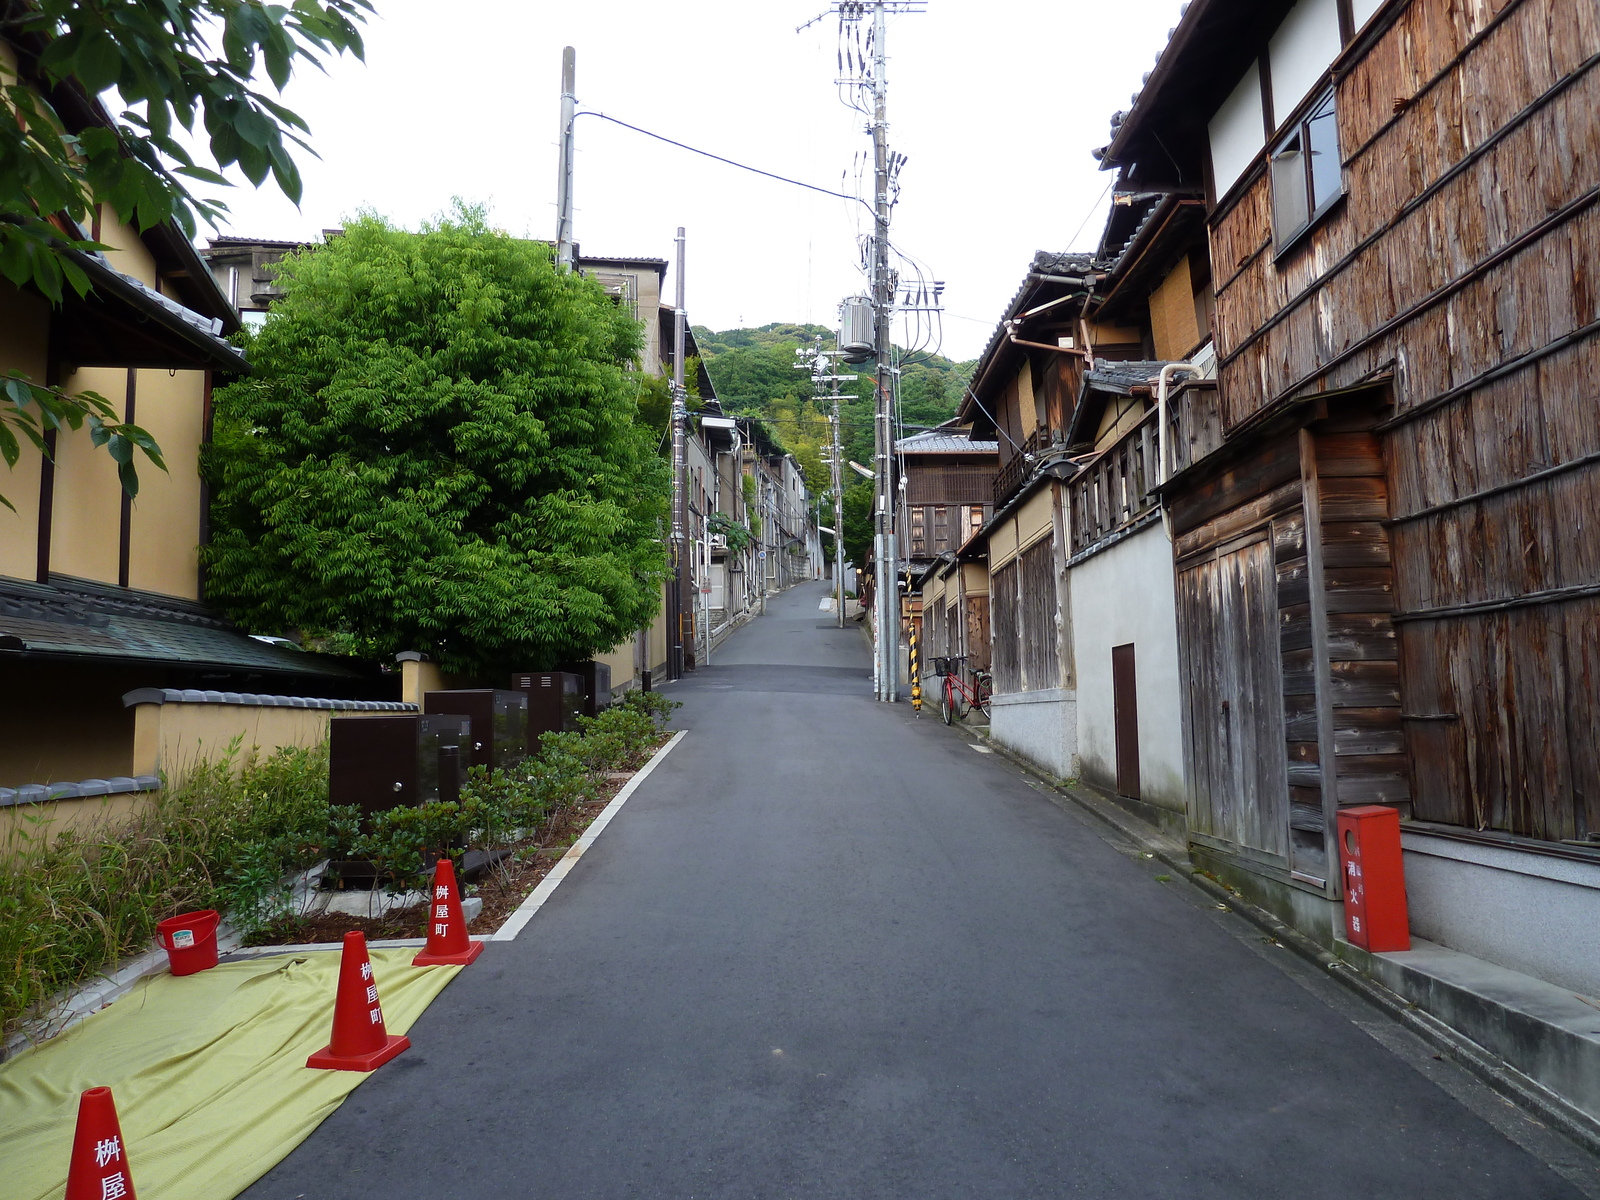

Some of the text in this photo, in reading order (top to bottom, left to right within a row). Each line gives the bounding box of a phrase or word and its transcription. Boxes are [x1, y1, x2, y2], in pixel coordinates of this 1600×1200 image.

[435, 885, 449, 938] 桝屋町
[1347, 860, 1361, 933] 消火器
